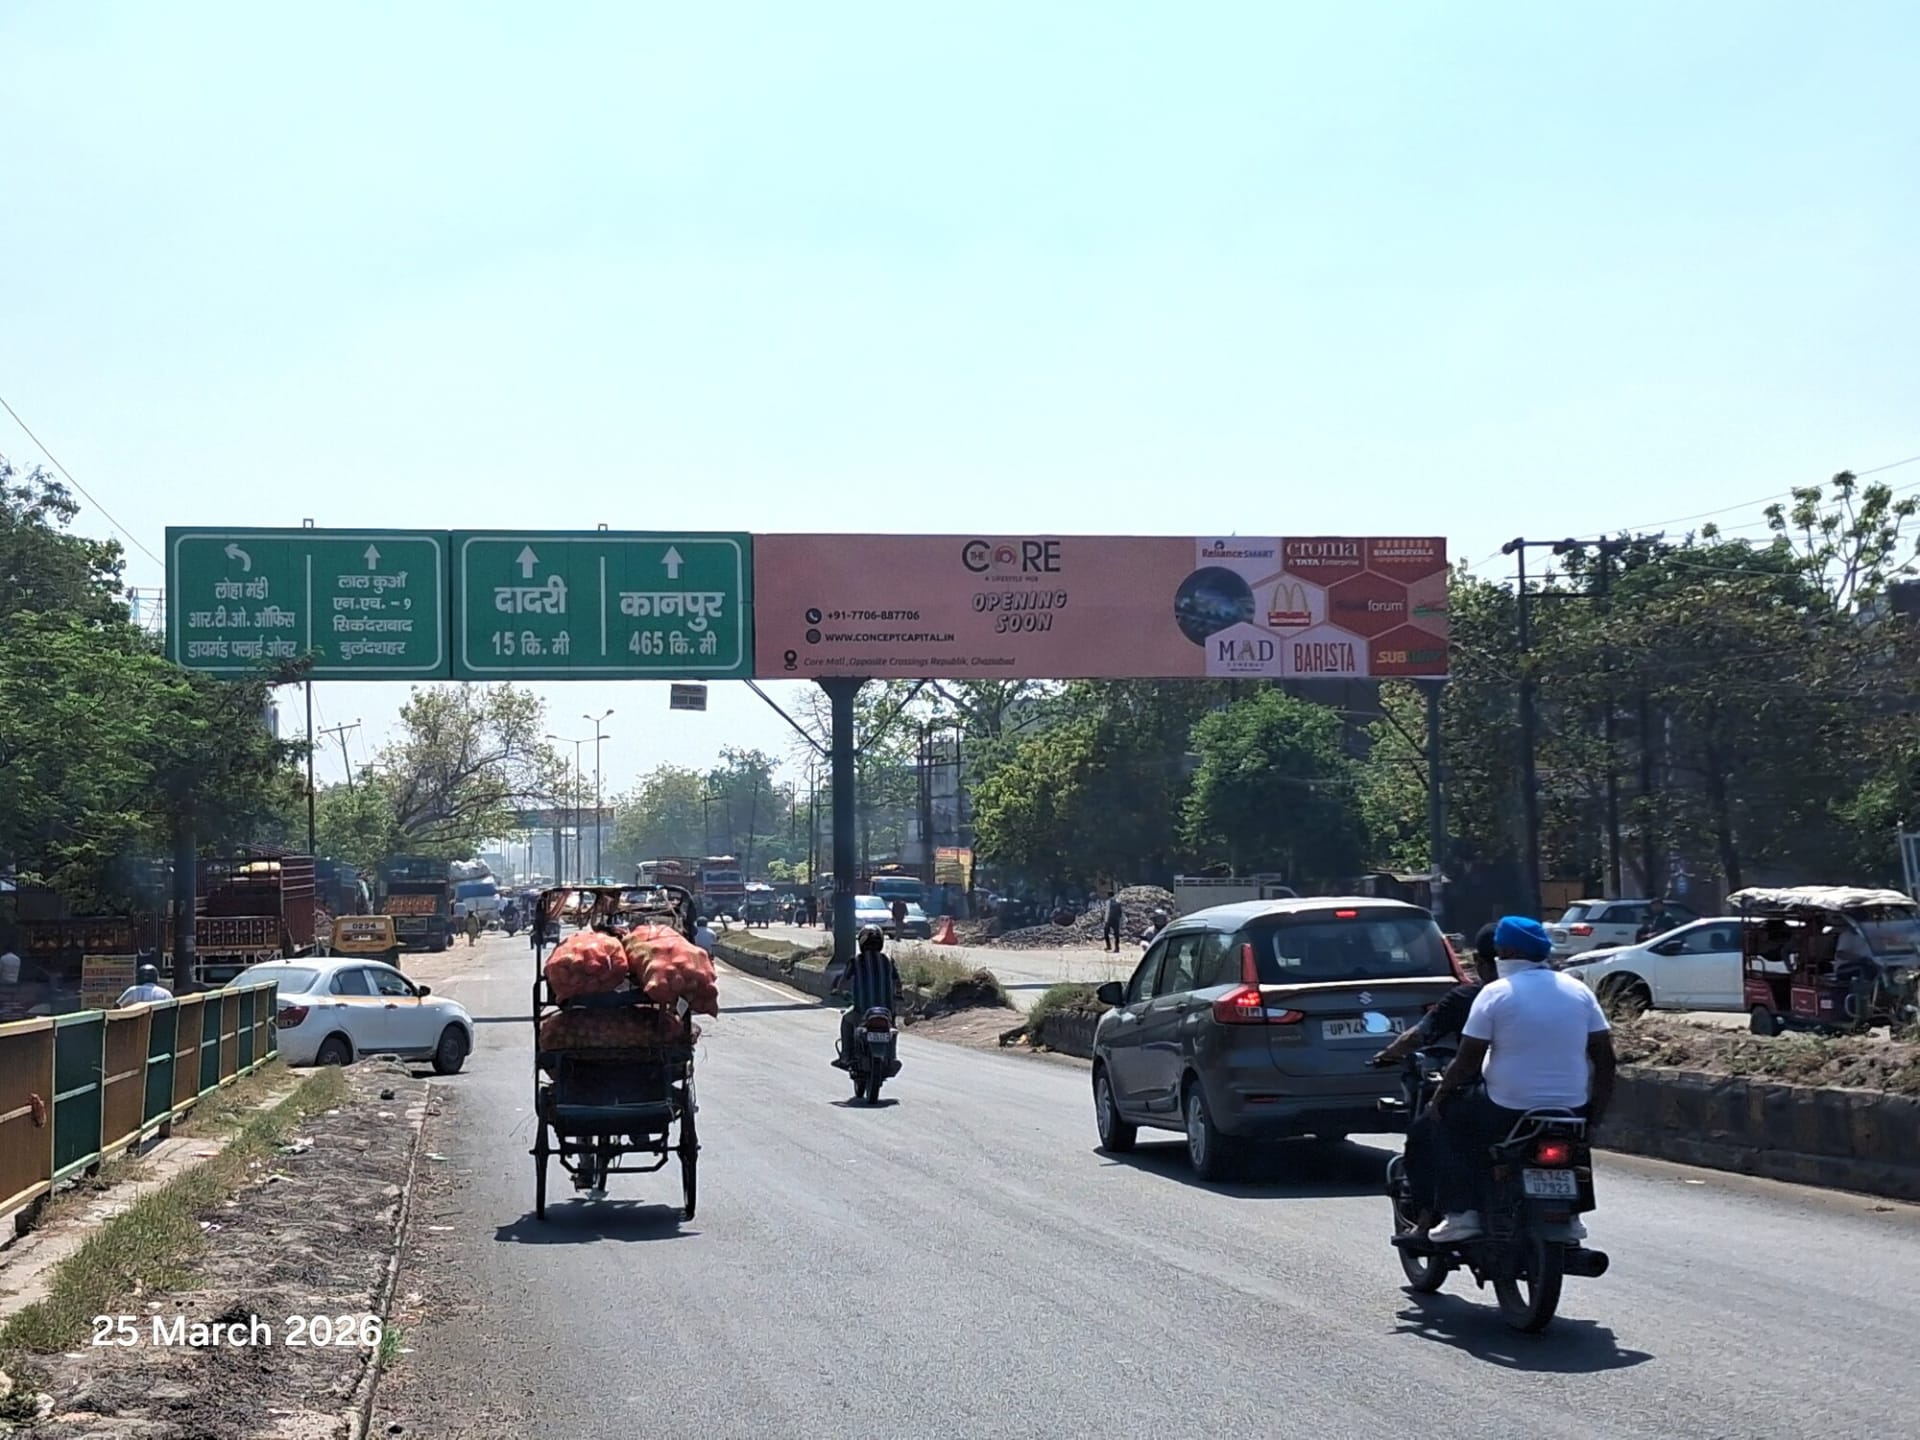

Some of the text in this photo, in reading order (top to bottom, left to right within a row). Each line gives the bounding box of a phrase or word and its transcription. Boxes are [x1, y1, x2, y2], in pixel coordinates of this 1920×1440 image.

[1286, 542, 1360, 557] croma
[214, 576, 269, 600] लोहा मंडी
[337, 575, 370, 589] लाल
[494, 574, 568, 614] दादरी
[972, 589, 1068, 612] OPENING
[619, 592, 726, 632] कानपुर
[828, 610, 920, 621] +91-7706-887706
[1368, 600, 1403, 611] forum
[995, 612, 1053, 634] SOON
[187, 636, 229, 658] डायमंड
[266, 636, 298, 658] ओवर
[492, 631, 515, 656] 15
[552, 630, 570, 656] मी
[629, 631, 664, 656] 465
[700, 630, 717, 656] मी
[825, 633, 955, 642] WWW.CONCEPTCAPITAL.IN
[803, 657, 823, 666] Core
[889, 657, 929, 668] Crossings
[1294, 643, 1355, 672] BARISTA
